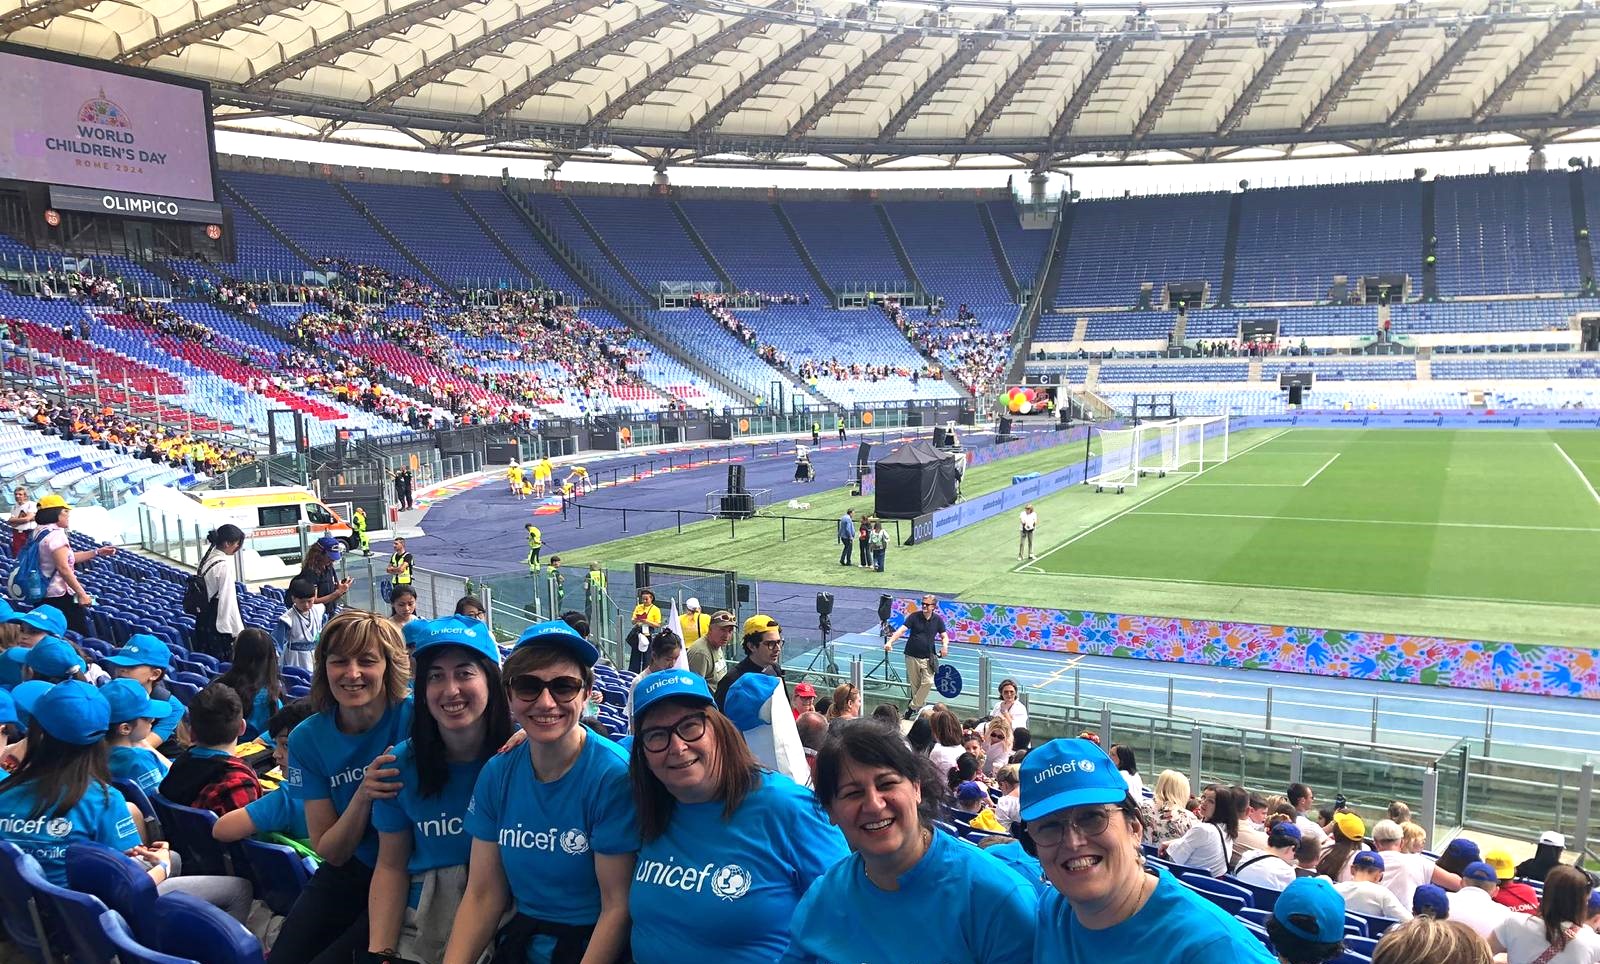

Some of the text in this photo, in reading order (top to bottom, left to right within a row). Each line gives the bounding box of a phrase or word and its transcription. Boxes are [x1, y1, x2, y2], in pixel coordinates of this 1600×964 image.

[77, 125, 135, 144] WORLD
[45, 138, 167, 165] CHILDREN'S DAY
[75, 159, 144, 174] ROME 2024
[102, 195, 179, 216] OLIMPICO
[1040, 374, 1049, 384] C
[913, 520, 933, 541] 00:00
[944, 666, 952, 680] 2
[645, 675, 679, 694] unicef
[941, 679, 957, 694] BS
[1034, 759, 1077, 784] unicef
[0, 813, 47, 834] nicef
[417, 812, 463, 837] nic
[636, 856, 715, 893] unicef
